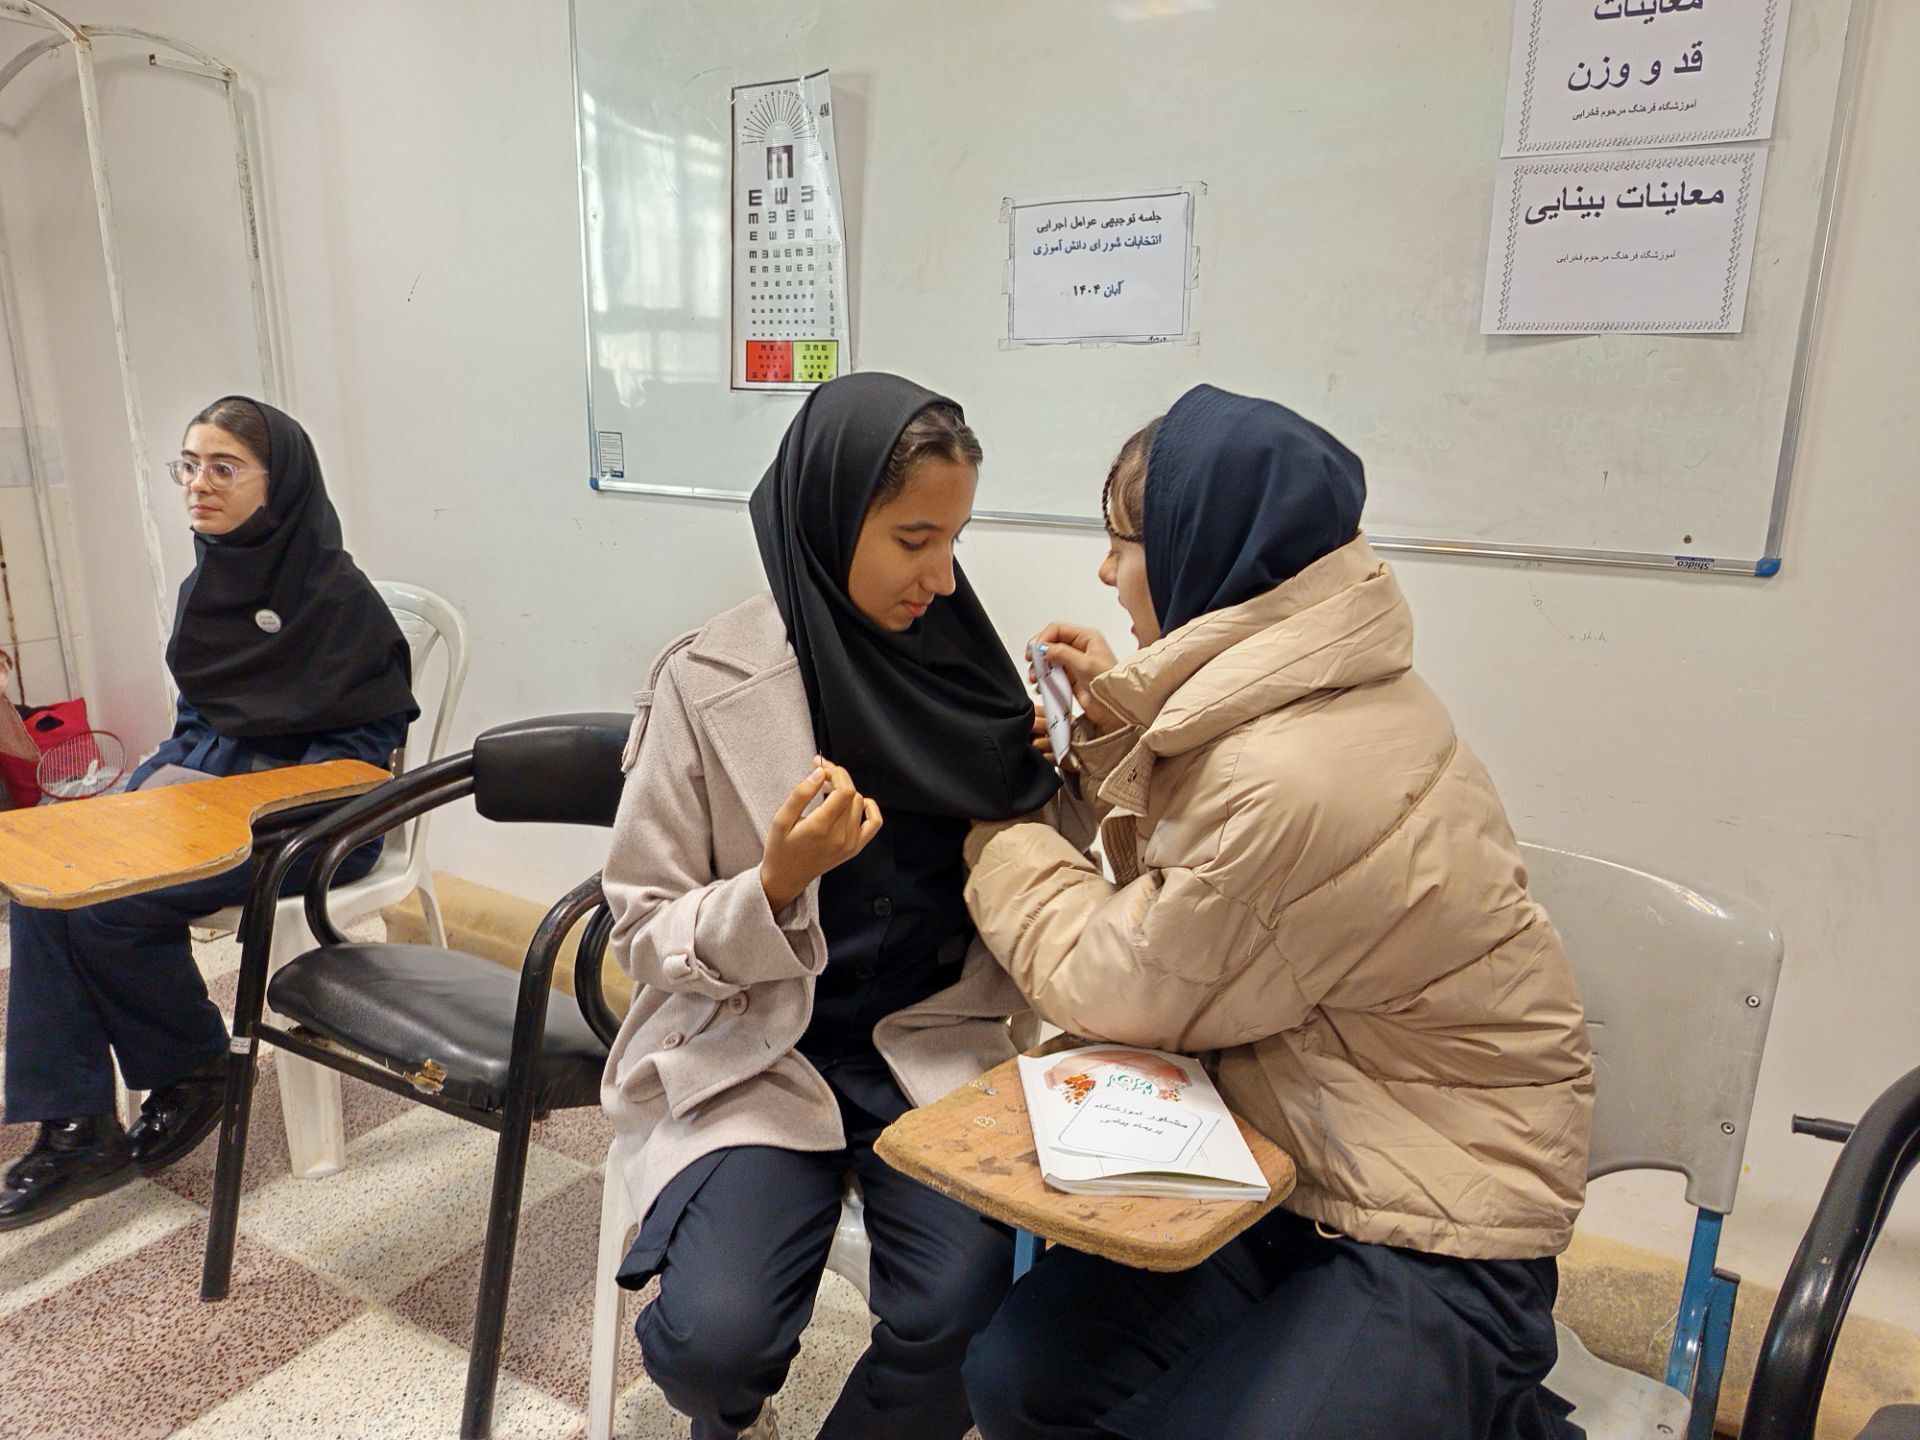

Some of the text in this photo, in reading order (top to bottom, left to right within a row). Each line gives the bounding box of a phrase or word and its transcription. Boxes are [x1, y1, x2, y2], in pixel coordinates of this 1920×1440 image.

[1567, 40, 1703, 91] قد و وزن
[1572, 107, 1599, 120] فخرایی
[1601, 109, 1626, 118] مرحوم
[1628, 102, 1657, 114] فرهنگ
[1524, 181, 1724, 225] معاینات بینایی
[1036, 210, 1162, 233] جلسه توجیهی عوامل اجرایی
[1033, 234, 1162, 255] انتخابات شورای دانش آموزی
[1583, 255, 1609, 264] مرحوم
[1611, 251, 1638, 261] فرهنگ
[1073, 280, 1125, 298] آبان ۱۴۰۴
